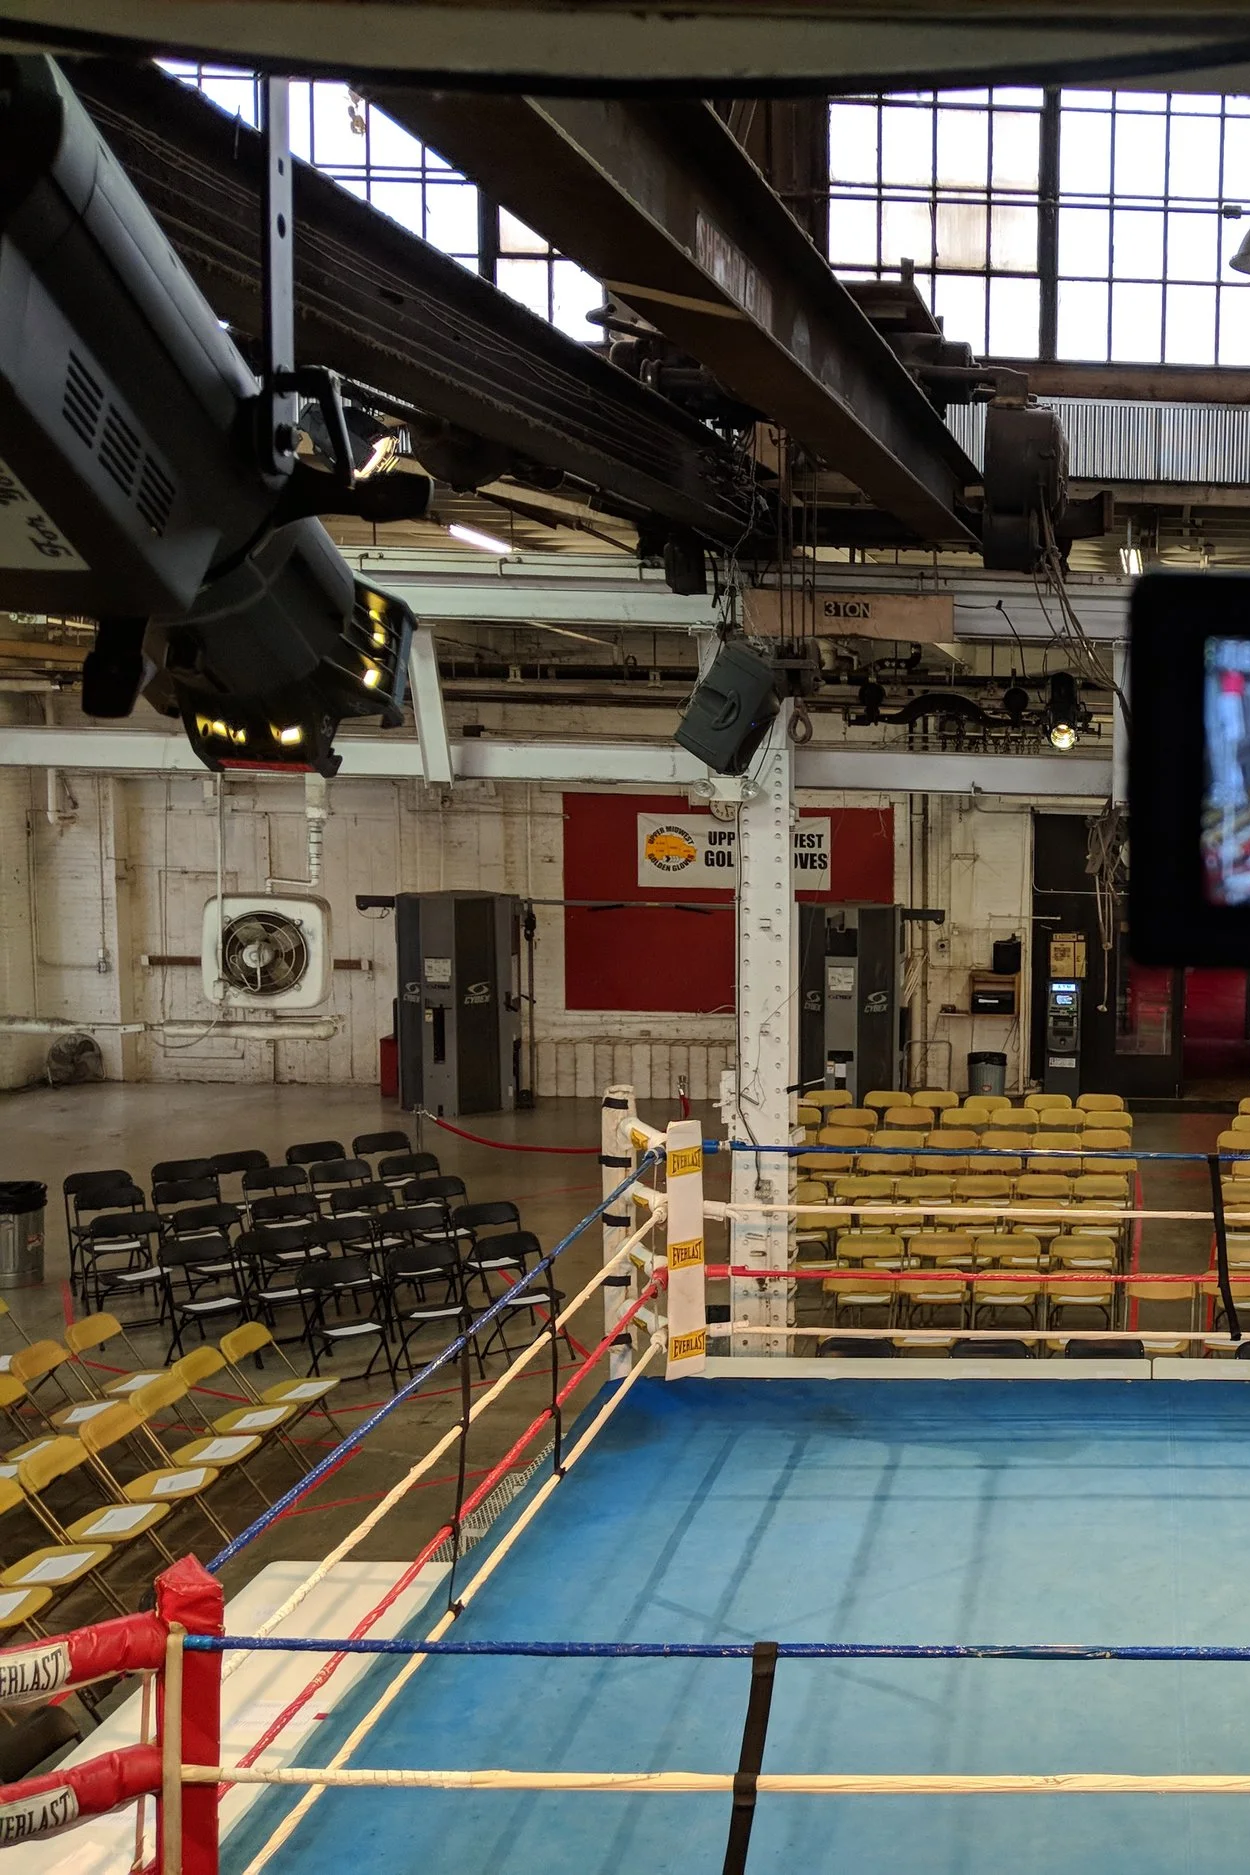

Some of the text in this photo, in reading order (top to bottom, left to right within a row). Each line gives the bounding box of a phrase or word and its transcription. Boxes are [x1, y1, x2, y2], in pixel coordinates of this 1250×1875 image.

[665, 826, 695, 845] MIDWEST
[708, 831, 736, 847] UPP
[704, 850, 735, 868] GOL
[864, 1003, 888, 1014] CYBEX
[672, 1148, 702, 1174] EVERLAST
[673, 1241, 702, 1267] EVERLAST
[674, 1332, 706, 1359] EVERLAST
[0, 1648, 62, 1697] ERLAST
[0, 1791, 70, 1842] ERLAST
